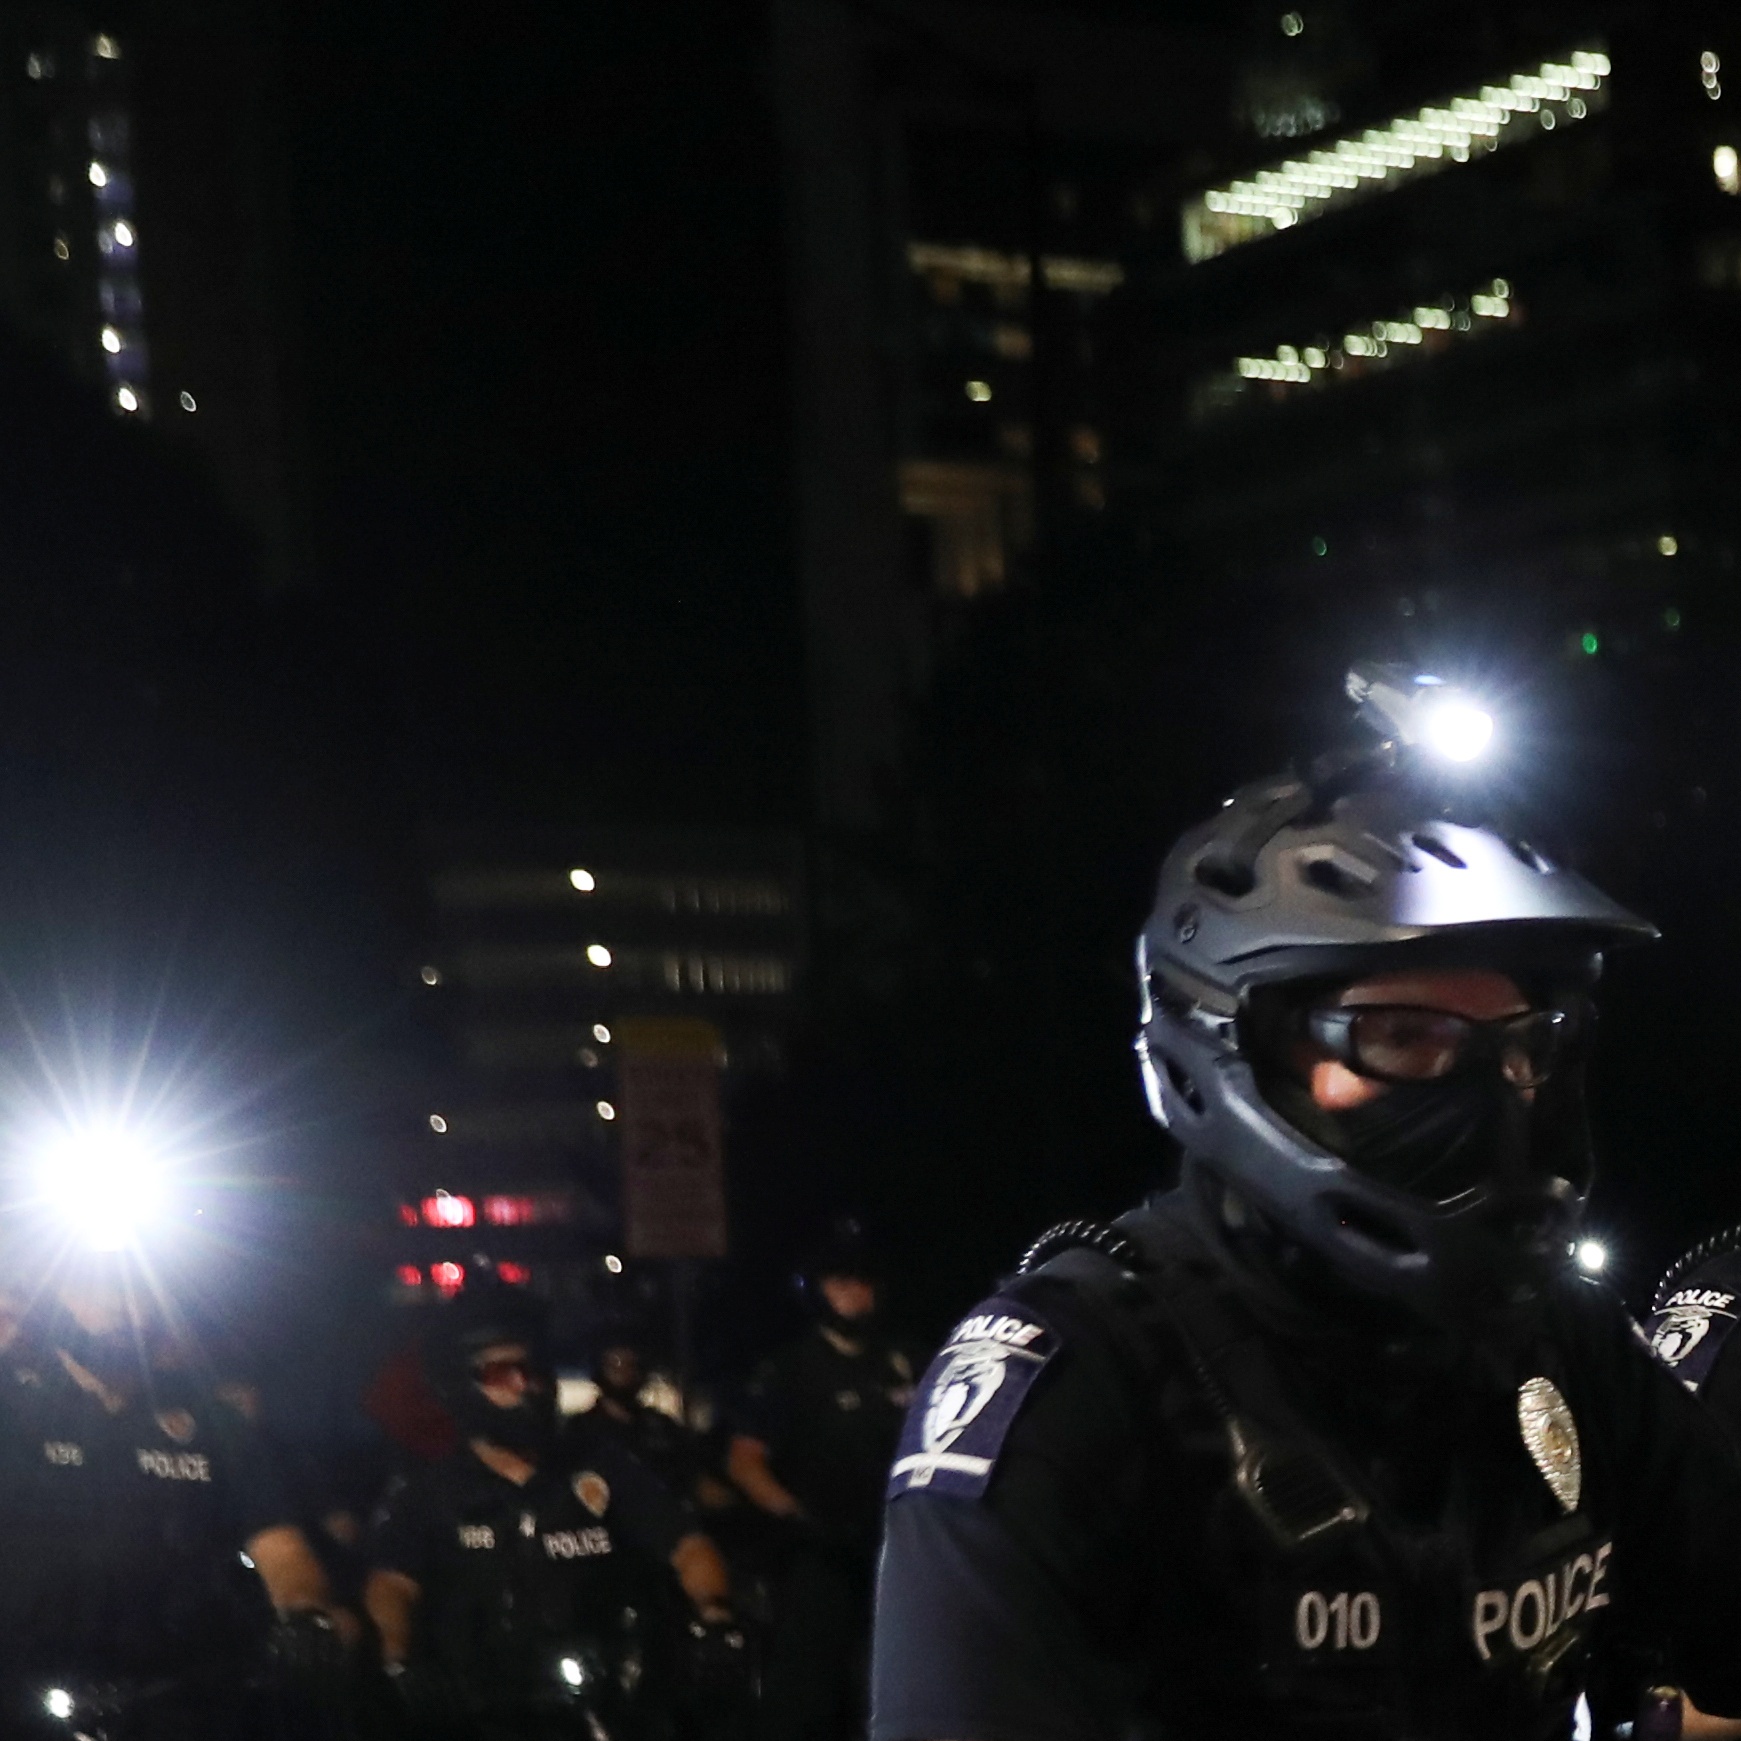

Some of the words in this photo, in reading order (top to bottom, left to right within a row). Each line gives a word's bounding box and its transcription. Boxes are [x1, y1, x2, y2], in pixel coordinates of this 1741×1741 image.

[1665, 1289, 1736, 1309] POLICE
[949, 1314, 1046, 1348] POLICE
[1295, 1590, 1381, 1650] 010
[1473, 1541, 1613, 1661] POLICE
